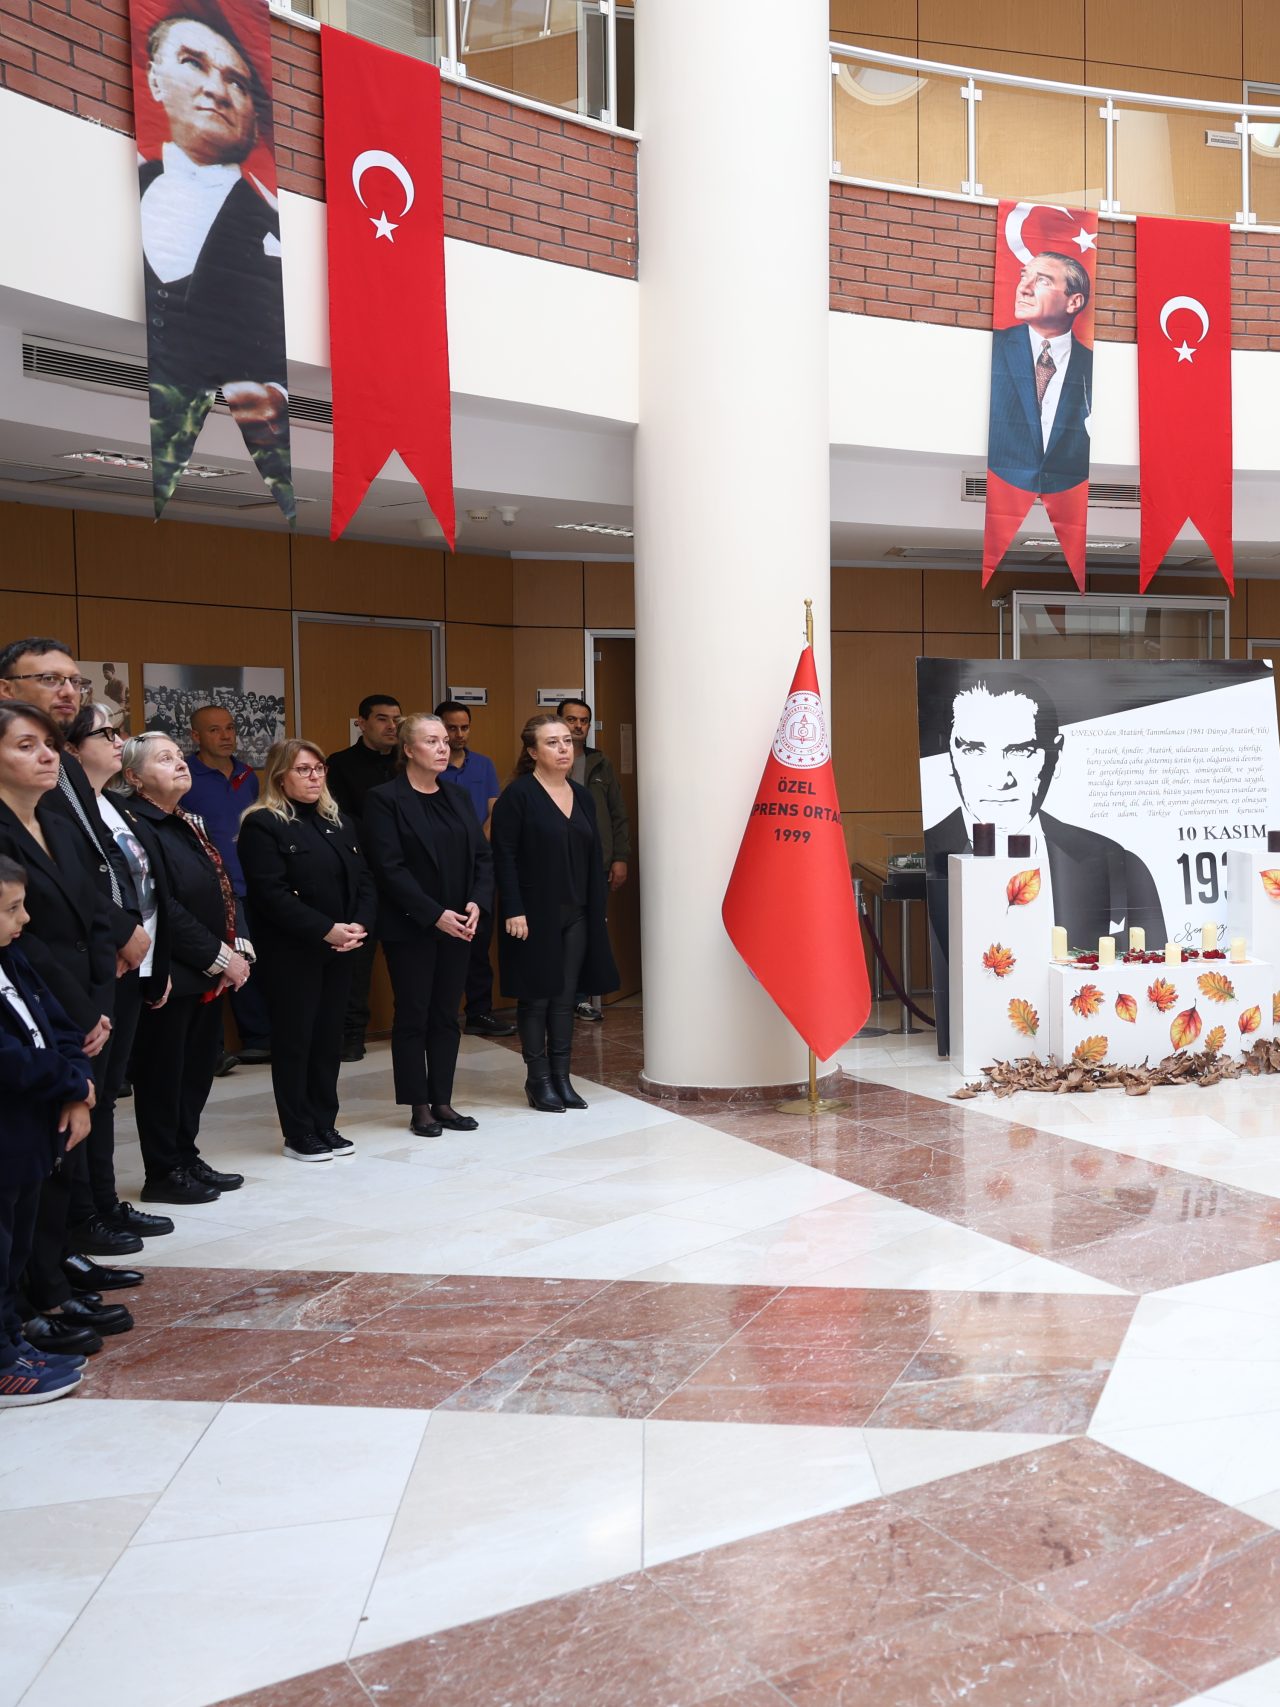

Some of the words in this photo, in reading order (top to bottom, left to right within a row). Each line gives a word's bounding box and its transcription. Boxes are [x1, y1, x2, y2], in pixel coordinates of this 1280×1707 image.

[1206, 727, 1228, 736] Dünya
[777, 776, 816, 795] ÖZEL
[753, 802, 799, 817] PRENS
[774, 828, 811, 843] 1999
[1177, 826, 1197, 841] 10
[1203, 824, 1268, 841] KASIM
